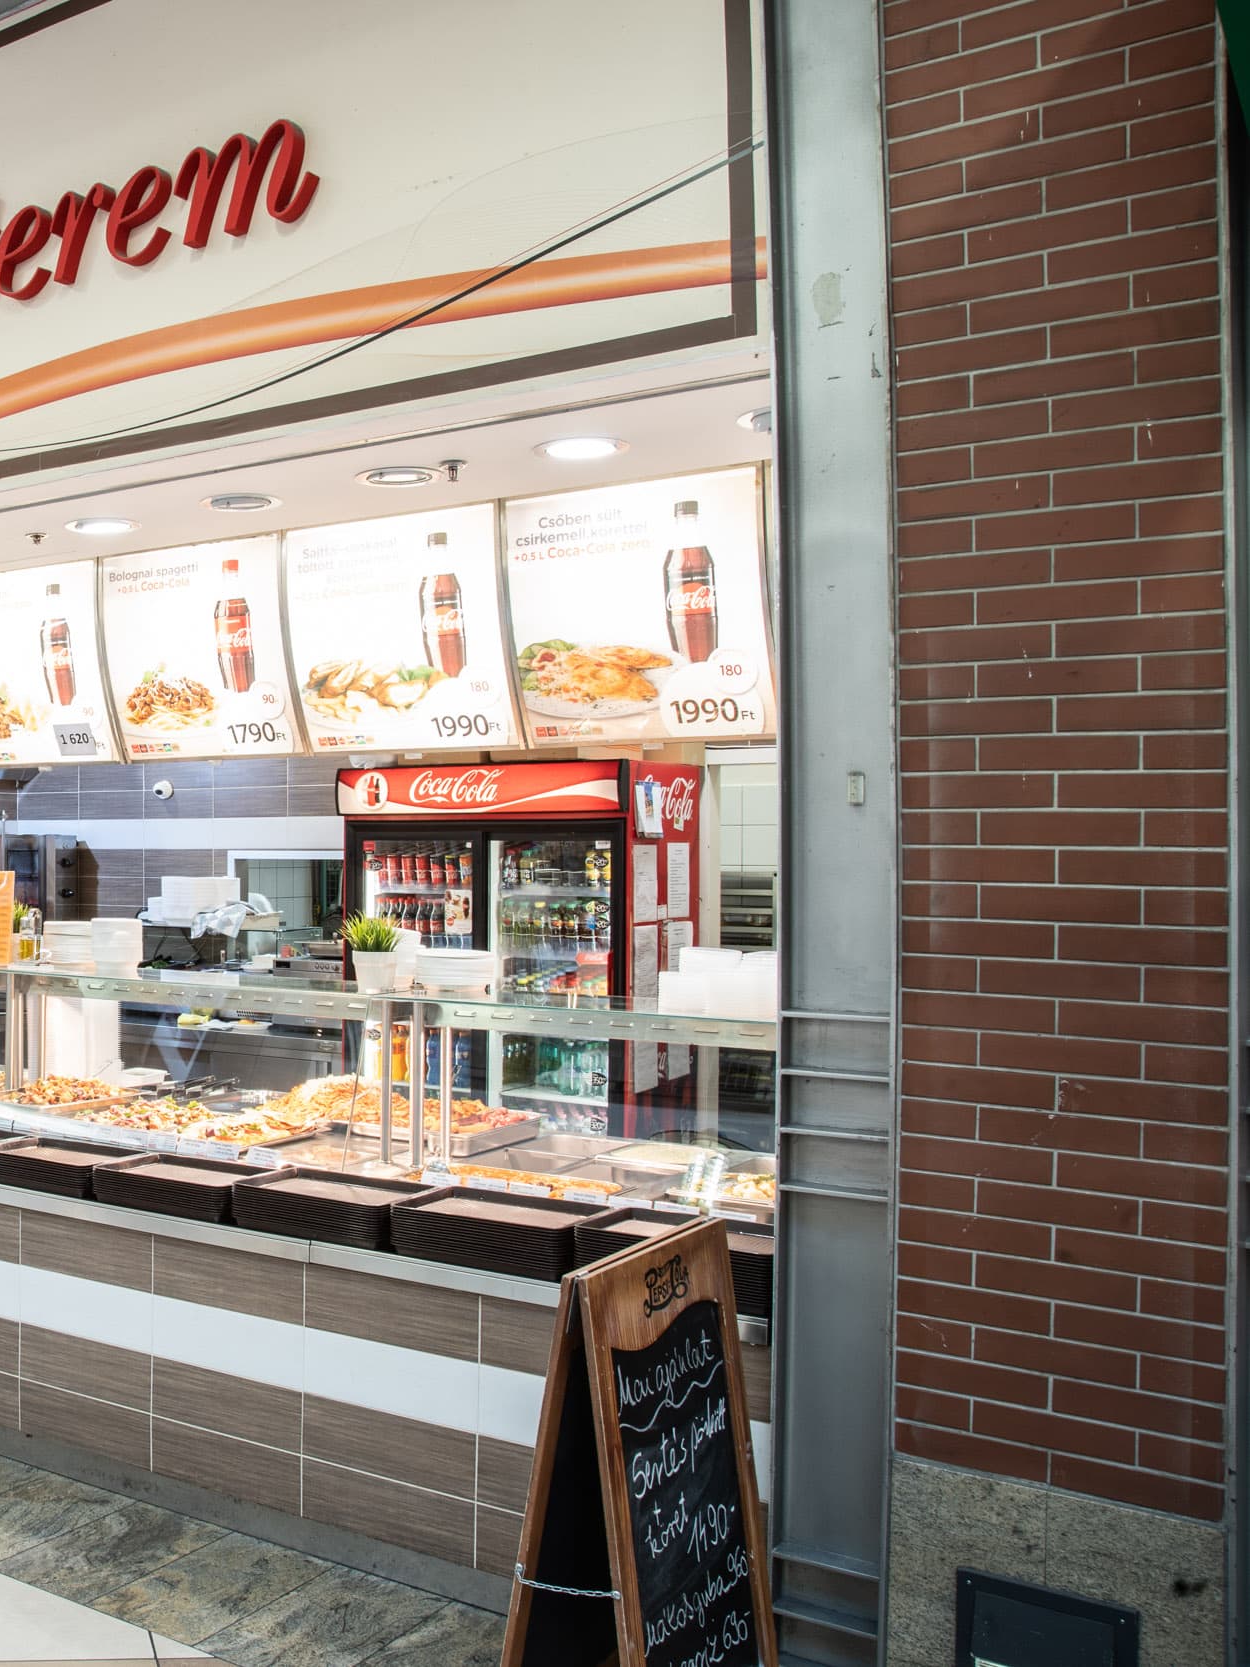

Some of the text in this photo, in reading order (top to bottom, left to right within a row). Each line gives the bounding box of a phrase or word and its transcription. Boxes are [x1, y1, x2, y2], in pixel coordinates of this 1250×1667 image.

[538, 508, 623, 529] Csőben sült
[547, 542, 616, 559] Coca-Cola
[109, 561, 199, 584] Bolognai spagetti
[141, 577, 191, 592] Coca-Cola
[719, 663, 743, 677] 180
[470, 680, 490, 693] 180
[409, 768, 505, 803] Coca-Cola
[617, 1329, 715, 1417] Mai ajánlat
[632, 1427, 687, 1499] Sertés
[644, 1491, 689, 1559] köret
